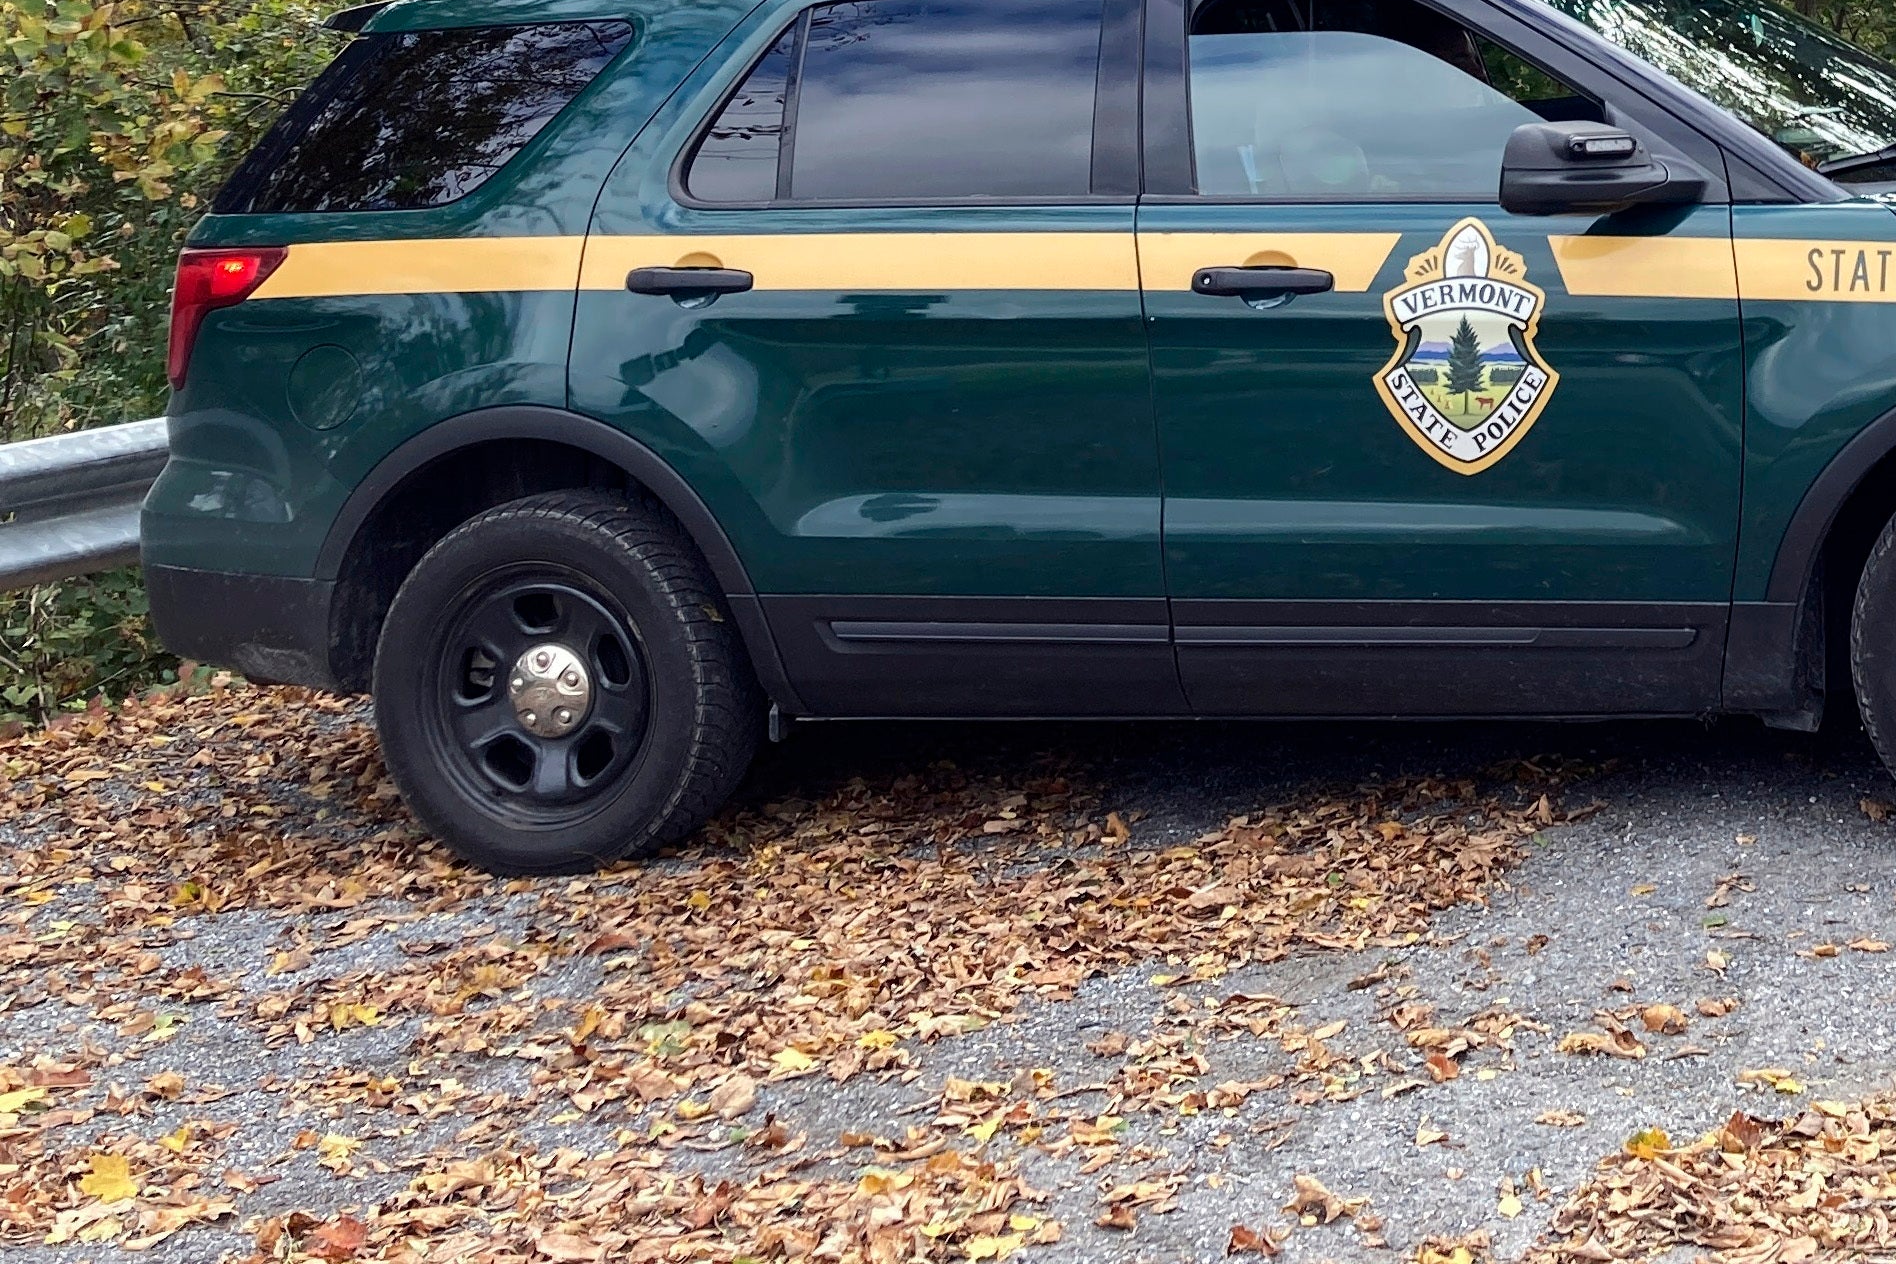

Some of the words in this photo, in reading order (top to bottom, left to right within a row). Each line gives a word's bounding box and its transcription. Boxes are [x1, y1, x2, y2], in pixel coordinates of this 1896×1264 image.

[1401, 283, 1531, 315] VERMONT
[1391, 373, 1458, 450] STATE
[1472, 372, 1543, 453] POLICE
